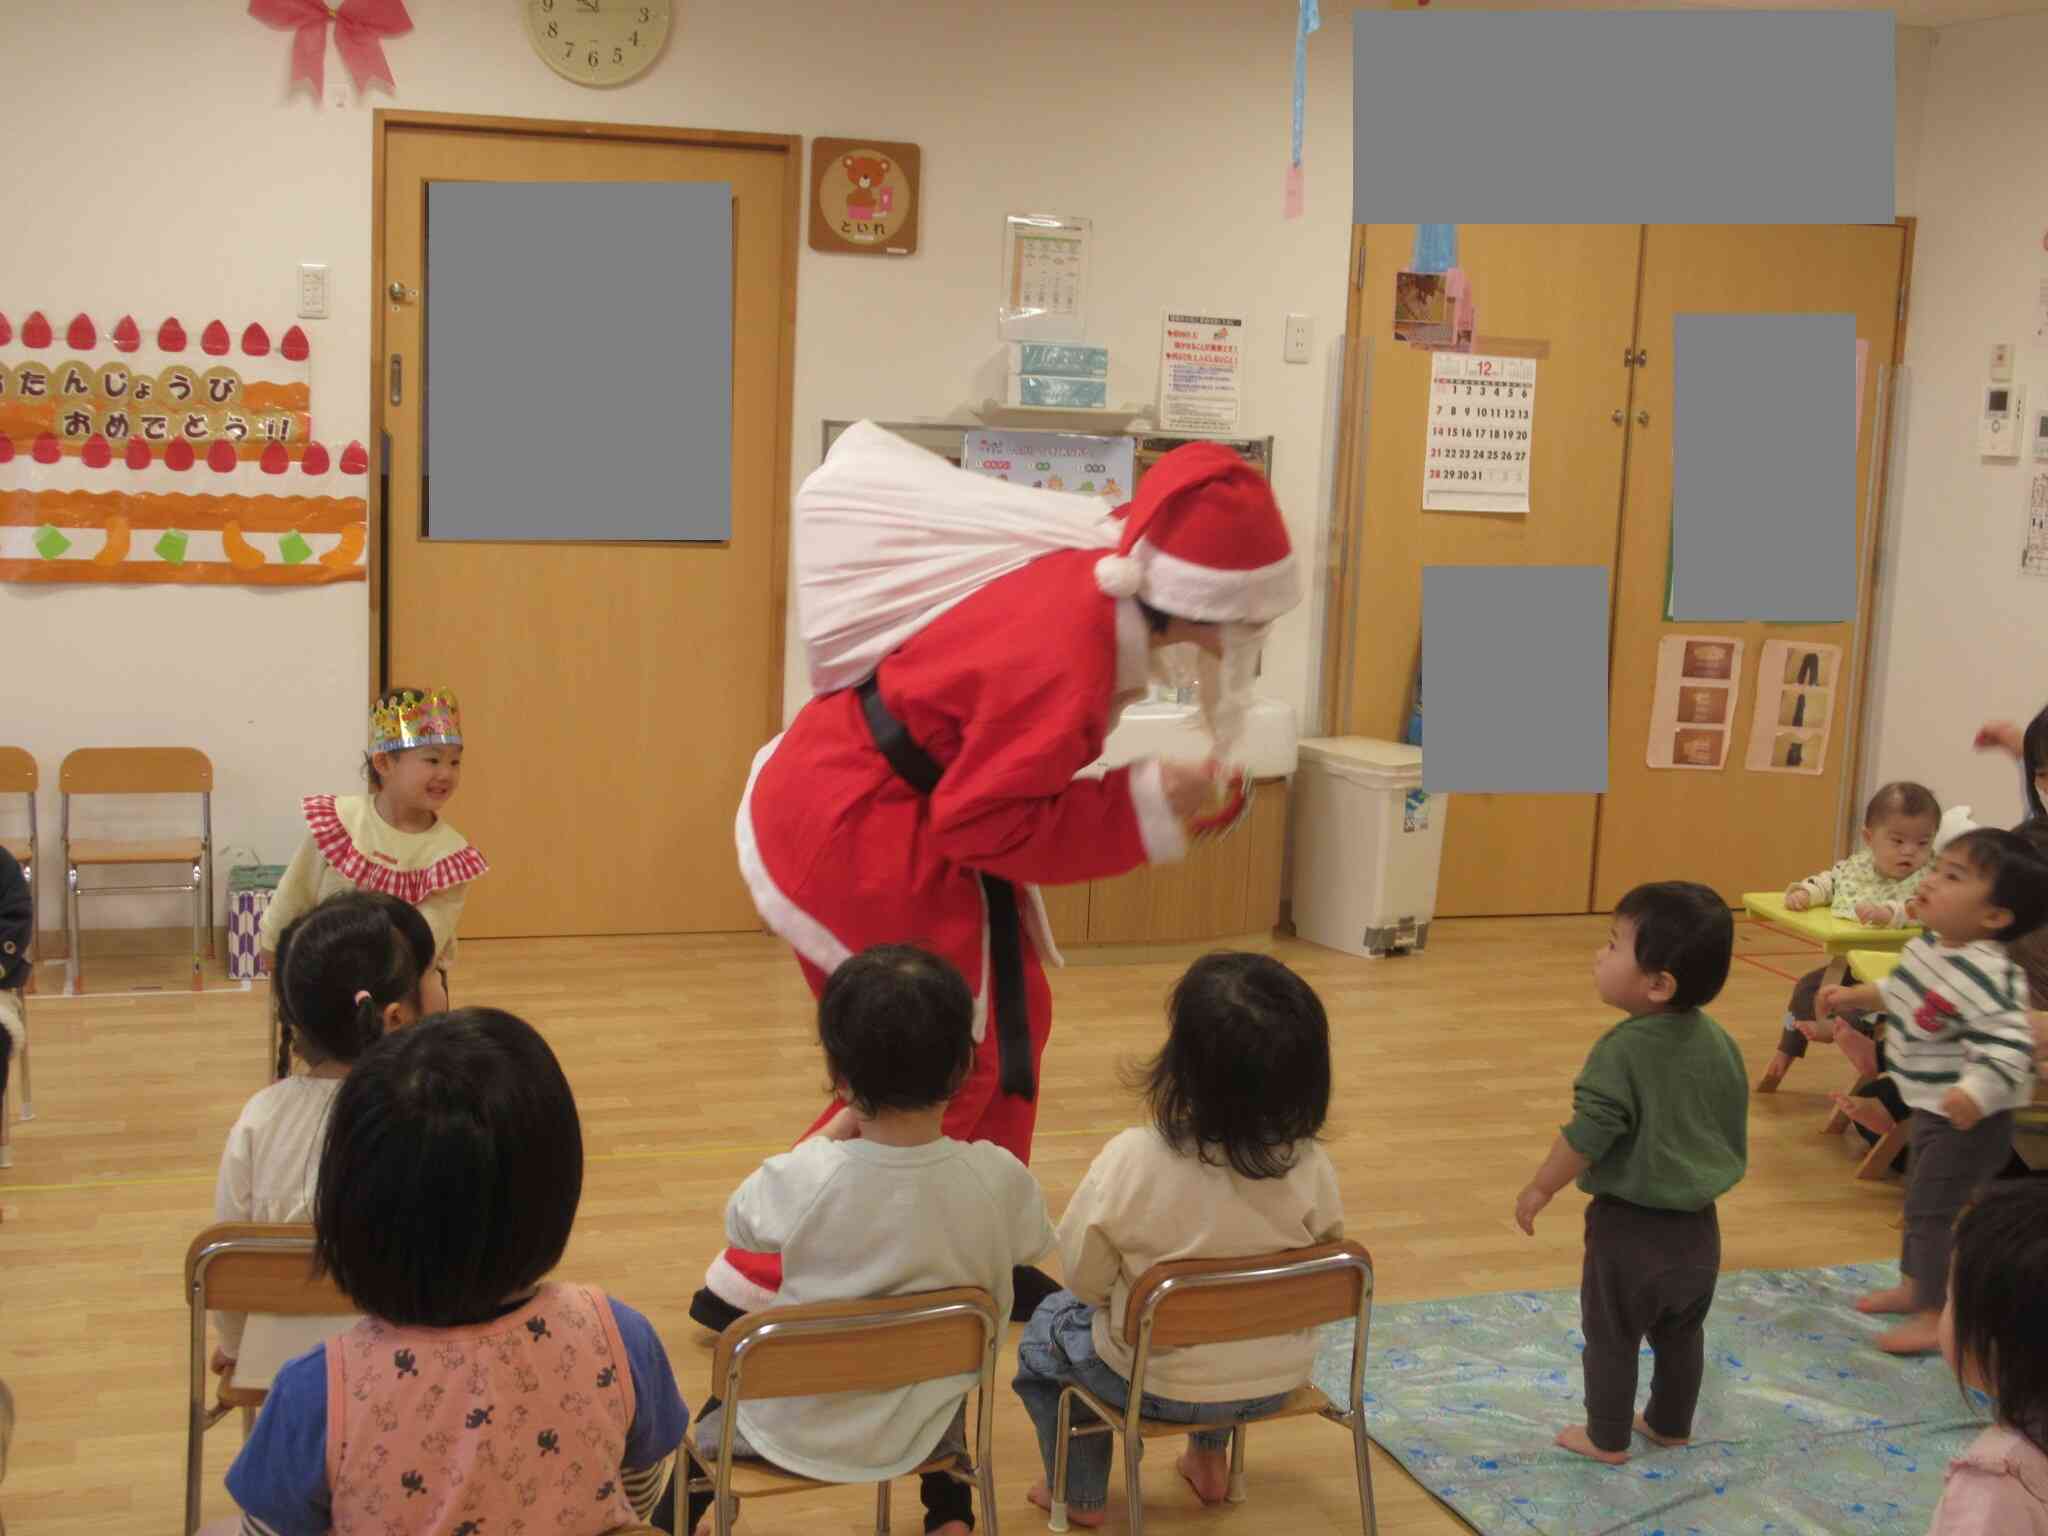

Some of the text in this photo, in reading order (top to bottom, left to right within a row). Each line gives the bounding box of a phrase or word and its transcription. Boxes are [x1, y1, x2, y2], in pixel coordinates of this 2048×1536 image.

[638, 7, 649, 23] 3
[547, 21, 558, 38] 8
[628, 31, 638, 47] 4
[564, 41, 574, 58] 7
[612, 48, 622, 64] 5
[588, 50, 599, 67] 6
[841, 221, 885, 236] といれ
[1477, 361, 1492, 376] 12
[0, 369, 236, 402] たんじょうび
[1477, 408, 1488, 417] 10
[1491, 409, 1501, 417] 11
[1505, 409, 1515, 418] 12
[1519, 410, 1529, 419] 13
[64, 410, 290, 441] おめでとう!!
[1433, 427, 1528, 441] 14 15 16 17 18 19 20
[1431, 448, 1526, 461] 21 22 23 24 25 26 27
[1430, 470, 1441, 479] 28
[1443, 470, 1455, 479] 29
[1457, 471, 1469, 480] 30
[1472, 471, 1482, 480] 31
